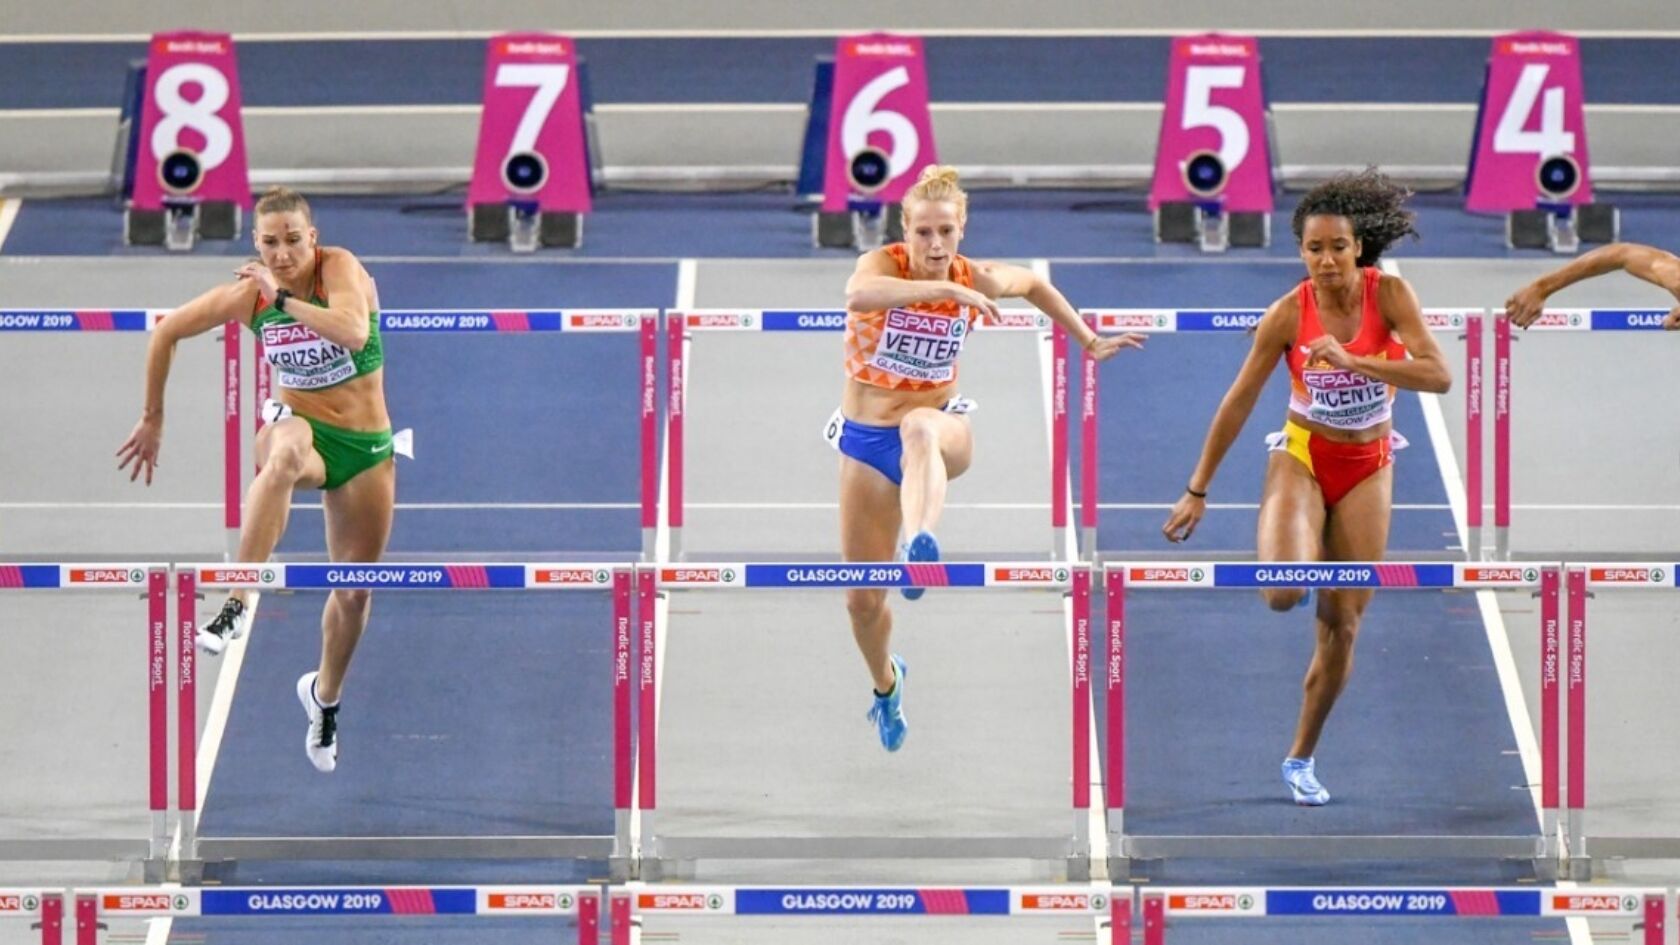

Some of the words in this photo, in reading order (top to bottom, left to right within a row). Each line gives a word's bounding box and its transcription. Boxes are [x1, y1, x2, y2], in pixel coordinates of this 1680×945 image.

[495, 64, 570, 154] 7
[1493, 64, 1575, 157] 4
[151, 63, 233, 171] 8
[841, 66, 919, 180] 6
[1178, 66, 1250, 172] 5
[0, 315, 40, 328] SGOW
[43, 315, 73, 328] 2019
[386, 315, 456, 328] GLASGOW
[459, 315, 489, 328] 2019
[798, 315, 845, 327] GLASG
[889, 312, 948, 334] SPAR
[1212, 315, 1260, 327] GLASG
[1628, 314, 1664, 326] GLAS
[886, 332, 961, 360] VETTER
[876, 358, 930, 378] GLASGOW
[281, 374, 329, 385] GLASGOW
[329, 366, 352, 381] 2019
[1305, 373, 1366, 388] SPAR
[272, 402, 284, 422] 7
[83, 570, 128, 581] SPAR
[214, 571, 259, 582] SPAR
[327, 570, 406, 583] GLASGOW
[409, 570, 442, 583] 2019
[549, 571, 593, 582] SPAR
[675, 570, 719, 581] SPAR
[786, 569, 866, 582] GLASGOW
[869, 569, 903, 582] 2019
[1008, 570, 1052, 581] SPAR
[1144, 569, 1188, 581] SPAR
[1255, 569, 1335, 582] GLASGOW
[1337, 569, 1371, 582] 2019
[1477, 569, 1521, 581] SPAR
[1604, 569, 1648, 581] SPAR
[152, 656, 163, 685] Sport
[180, 655, 192, 684] Sport
[616, 651, 628, 680] Sport
[641, 655, 653, 684] Sport
[1076, 653, 1088, 682] Sport
[1110, 655, 1121, 683] Sport
[1545, 653, 1556, 682] Sport
[1571, 654, 1582, 683] Sport
[0, 897, 18, 909] AR
[120, 896, 169, 909] SPAR
[248, 895, 339, 909] GLASGOW
[343, 895, 382, 909] 2019
[504, 895, 554, 908] SPAR
[655, 896, 704, 908] SPAR
[782, 895, 873, 909] GLASGOW
[876, 895, 915, 909] 2019
[1038, 896, 1087, 908] SPAR
[1186, 896, 1235, 909] SPAR
[1312, 895, 1404, 910] GLASGOW
[1407, 895, 1446, 910] 2019
[1569, 897, 1618, 909] SPAR
